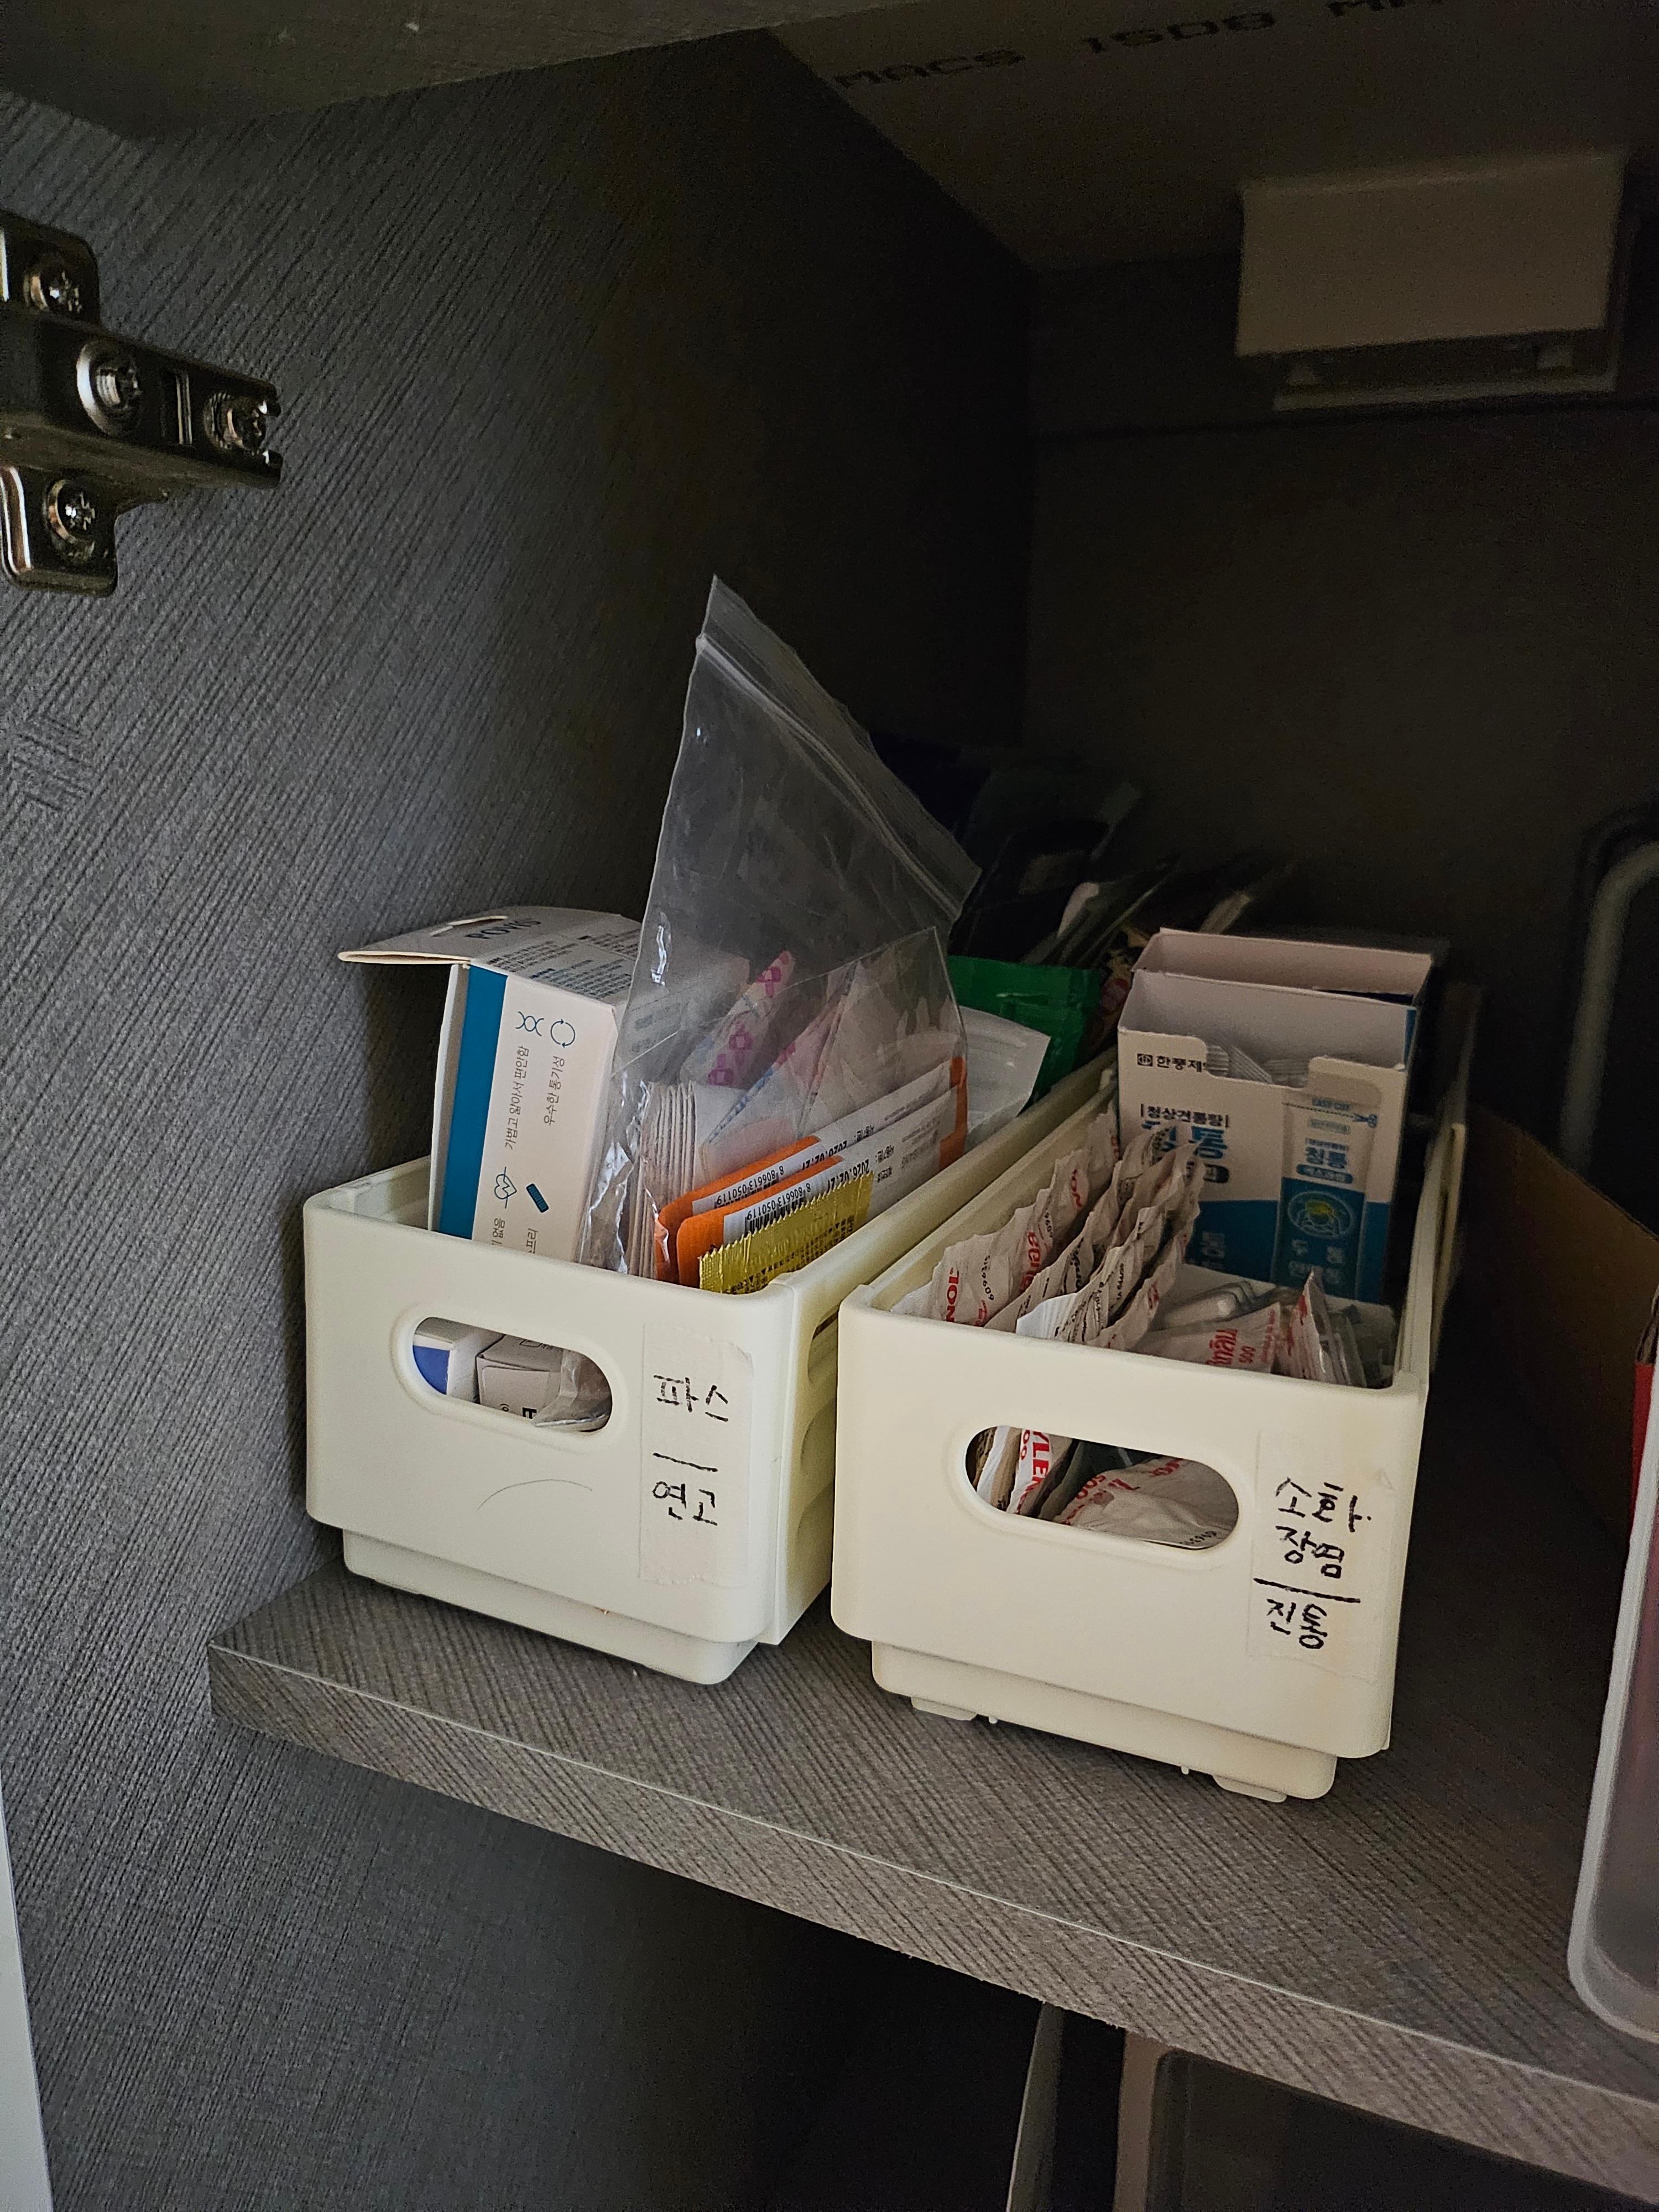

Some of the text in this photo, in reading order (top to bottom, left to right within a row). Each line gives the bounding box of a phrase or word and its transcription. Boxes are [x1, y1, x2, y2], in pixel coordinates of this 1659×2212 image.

[504, 1118, 519, 1150] 가볍고
[514, 1045, 529, 1079] 편안함
[544, 1055, 565, 1126] 우수한 통기성
[716, 1165, 784, 1205] 8 806613 050119
[746, 1182, 811, 1220] 8 806613 050119
[493, 1217, 505, 1238] 없음
[653, 1374, 729, 1423] 파스
[651, 1480, 718, 1526] 연고
[1275, 1525, 1345, 1579] 장염
[1266, 1598, 1329, 1650] 진통
